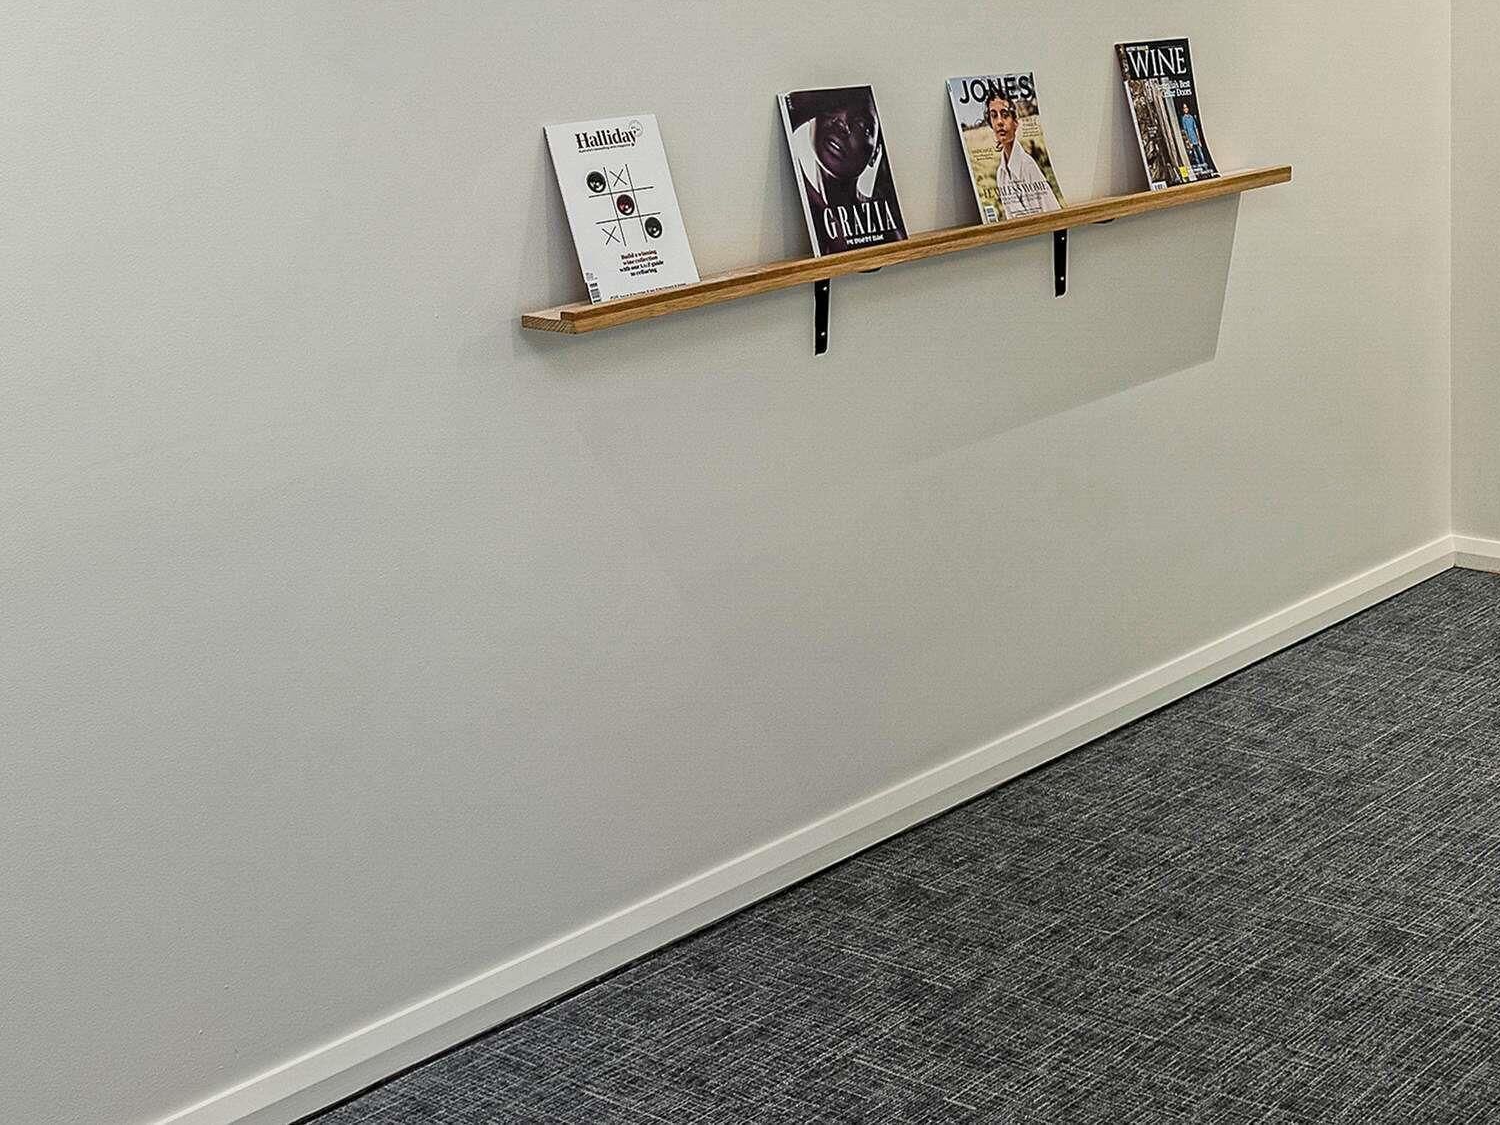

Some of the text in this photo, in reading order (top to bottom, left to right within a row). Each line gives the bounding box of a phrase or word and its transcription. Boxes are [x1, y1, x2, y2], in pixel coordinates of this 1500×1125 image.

[1127, 47, 1187, 78] WINE
[959, 75, 1033, 104] JONES
[575, 128, 637, 149] Halliday
[823, 200, 897, 239] GRAZIA
